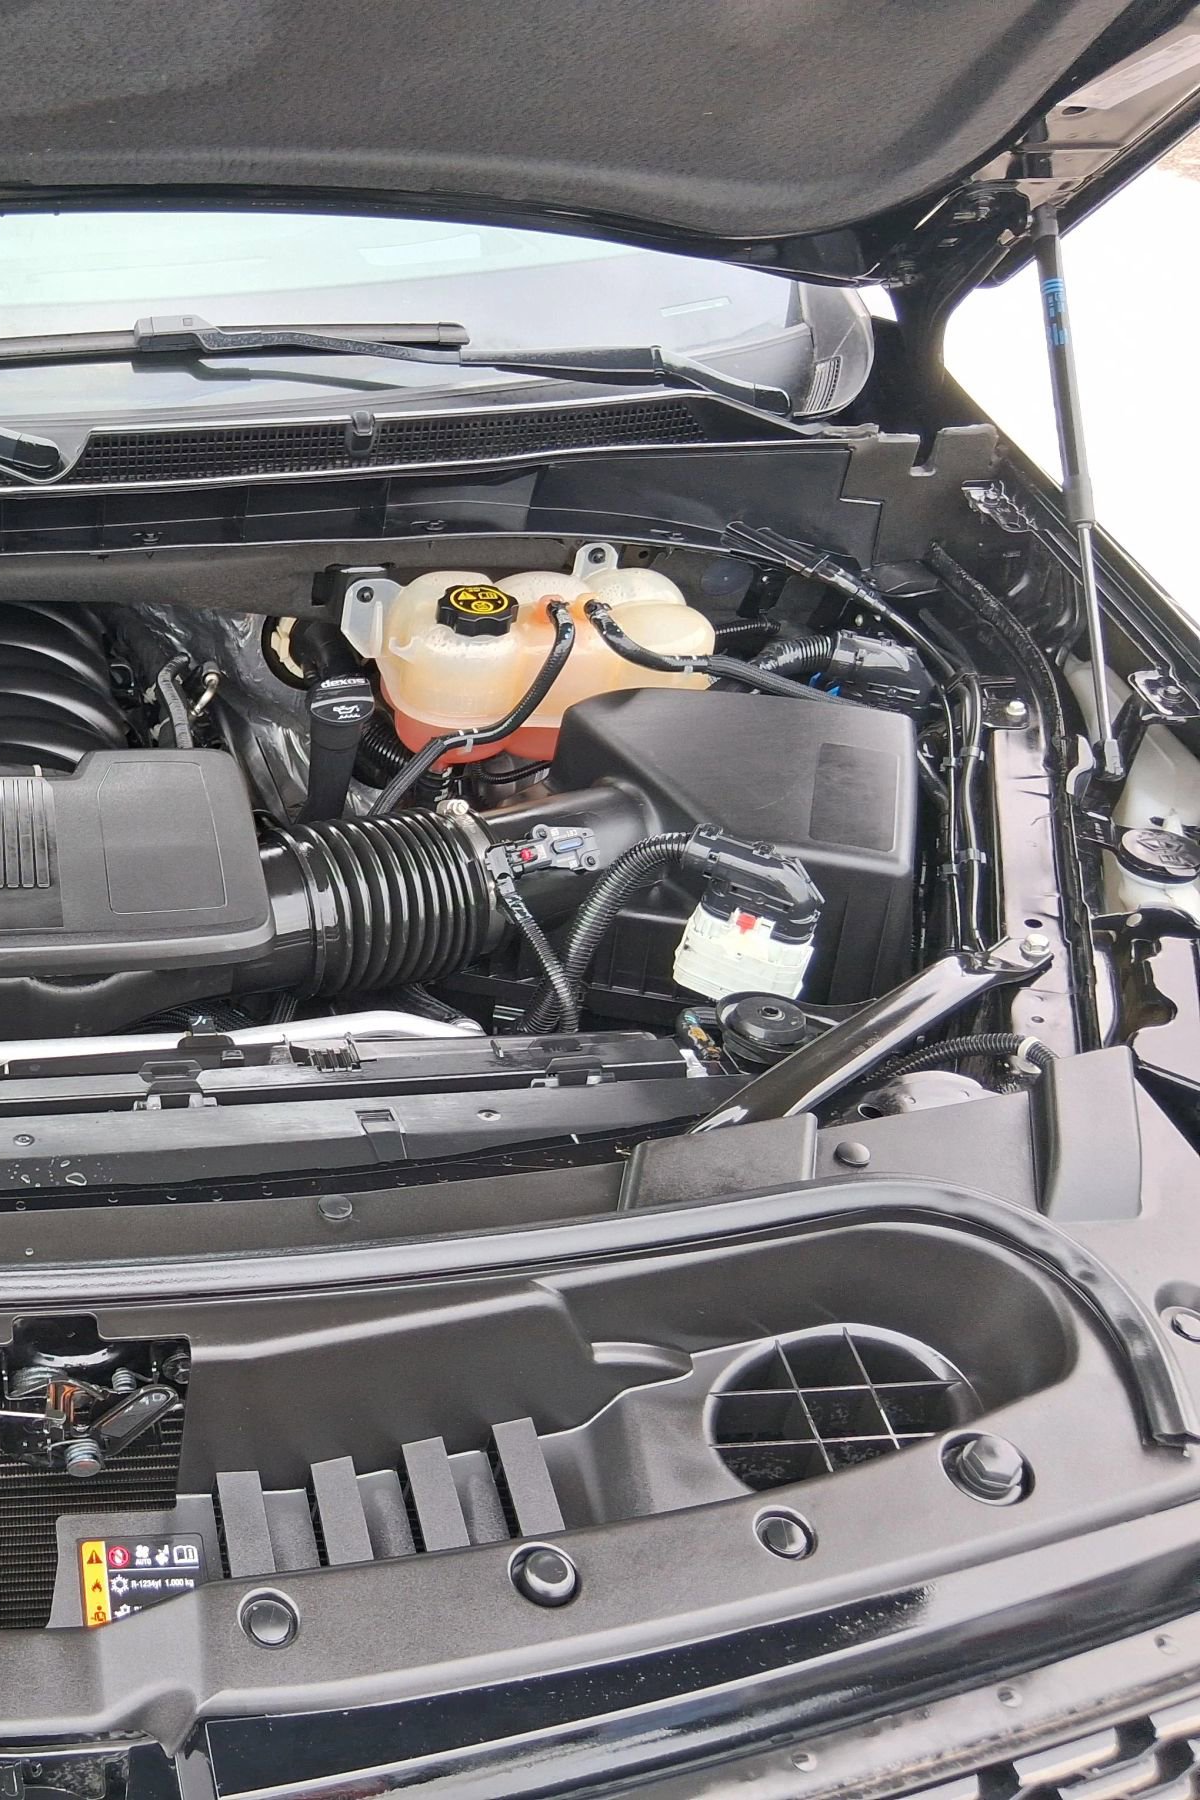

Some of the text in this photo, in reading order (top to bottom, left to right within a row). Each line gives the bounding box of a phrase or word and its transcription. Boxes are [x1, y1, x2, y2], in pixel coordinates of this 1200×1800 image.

[320, 678, 366, 689] dexos
[135, 1558, 152, 1566] AUTO
[165, 1578, 184, 1588] 1.000
[184, 1578, 195, 1589] kg
